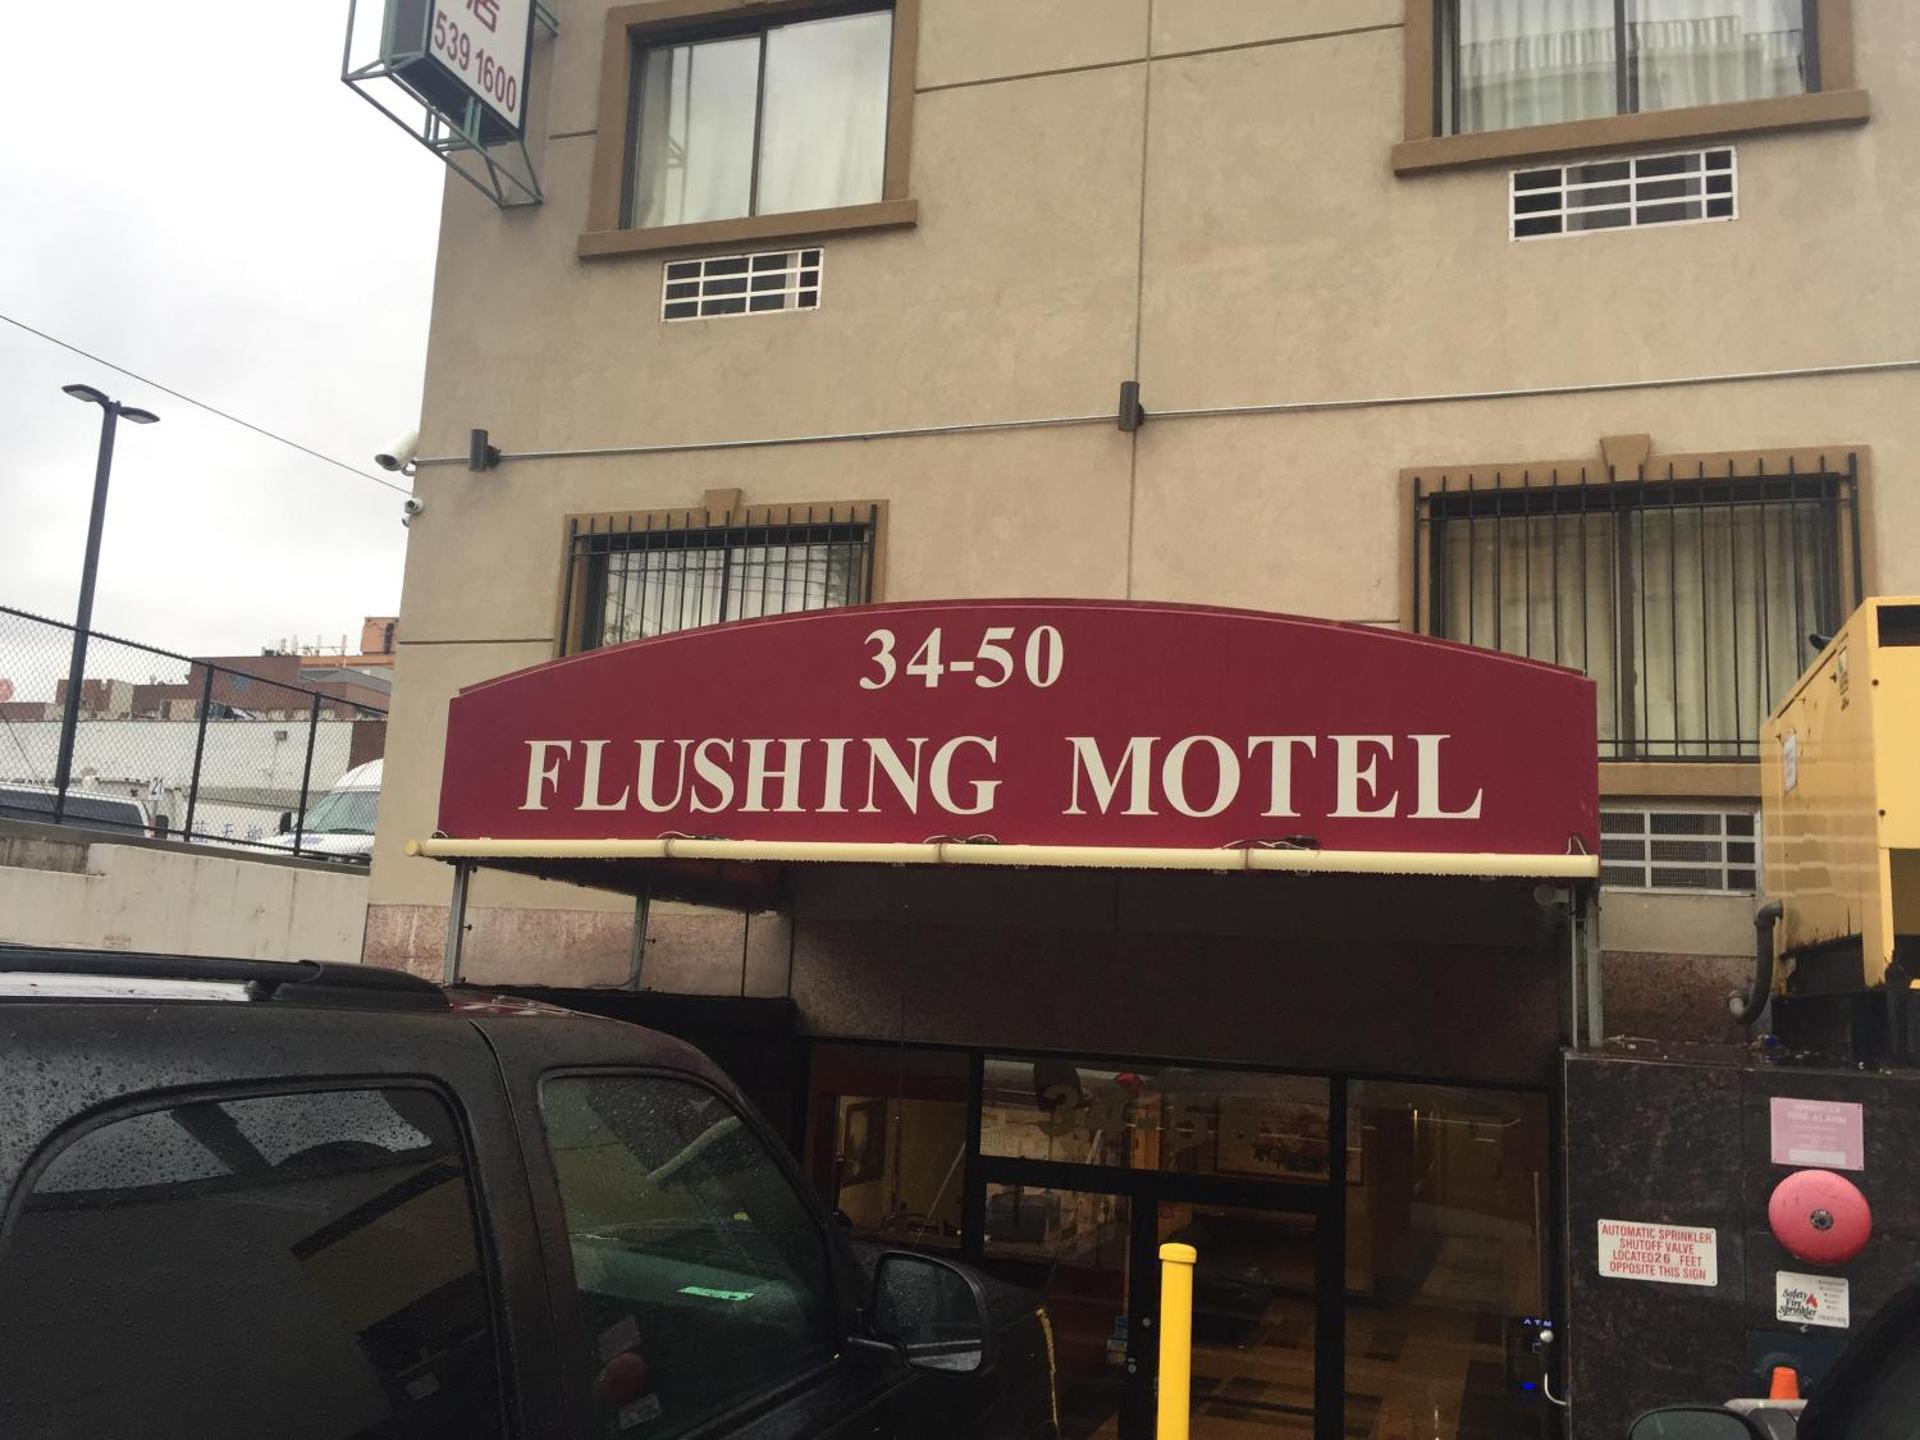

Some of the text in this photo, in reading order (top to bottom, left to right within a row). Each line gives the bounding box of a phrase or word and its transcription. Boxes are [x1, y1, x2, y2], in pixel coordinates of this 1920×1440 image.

[434, 10, 470, 71] 539
[475, 48, 517, 112] 1600
[859, 625, 1064, 690] 34-50
[517, 734, 1483, 819] FLUSHING MOTEL
[1602, 1224, 1712, 1244] AUTOMATIC SPRINKLER
[1619, 1238, 1694, 1255] SHUTOFF VALVE
[1612, 1249, 1702, 1267] LOCATED 26 FEET
[1609, 1261, 1706, 1280] OPPOSITE THIS SIGN
[1782, 1288, 1808, 1299] Safety
[1778, 1305, 1817, 1318] Sprinkler
[1523, 1318, 1552, 1328] ATM
